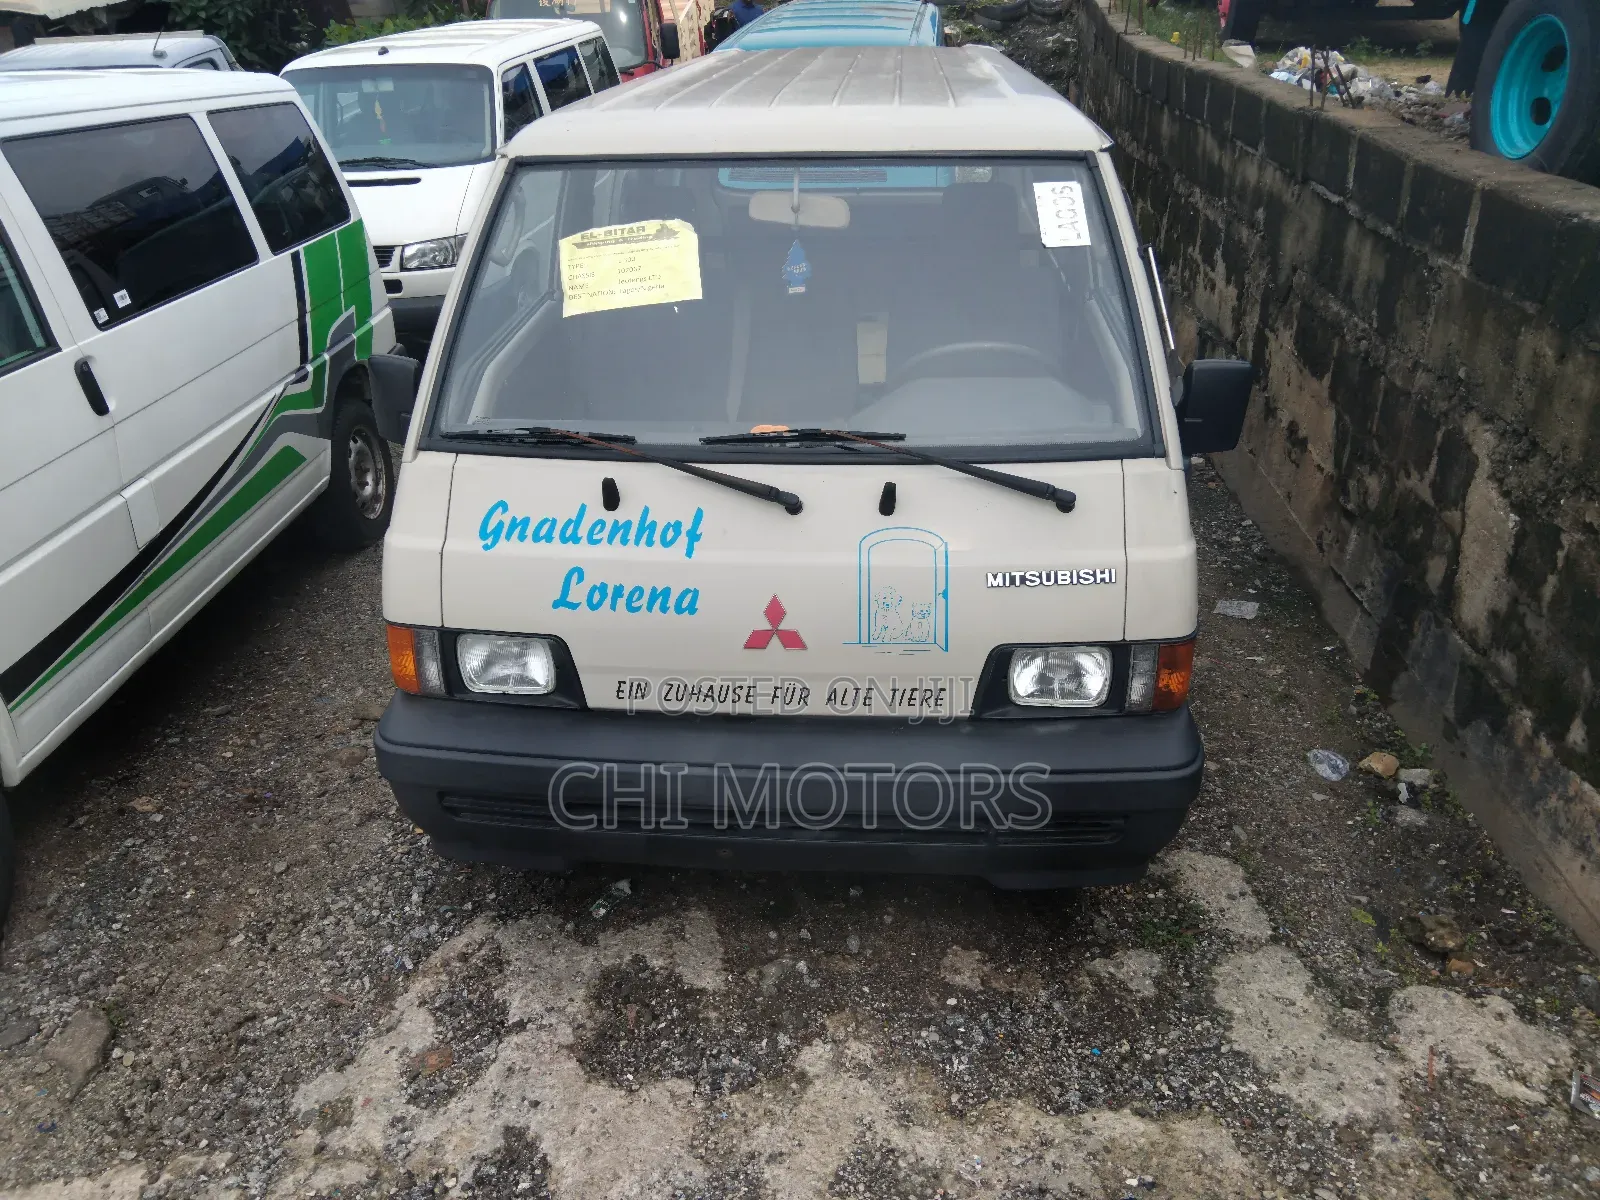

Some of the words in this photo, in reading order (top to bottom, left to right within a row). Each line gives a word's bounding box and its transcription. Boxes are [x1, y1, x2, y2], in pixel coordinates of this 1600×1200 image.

[580, 225, 646, 241] EL-BITAR
[568, 289, 616, 301] DESTNATION:
[478, 499, 704, 559] Gnadenhof
[986, 567, 1117, 588] MITSUBISHI
[551, 565, 700, 616] Lorena
[615, 680, 648, 700] EIN
[663, 682, 757, 704] ZUHAUSE
[770, 682, 811, 706] FÜR
[825, 687, 875, 707] ALTE
[889, 687, 947, 708] TIERE
